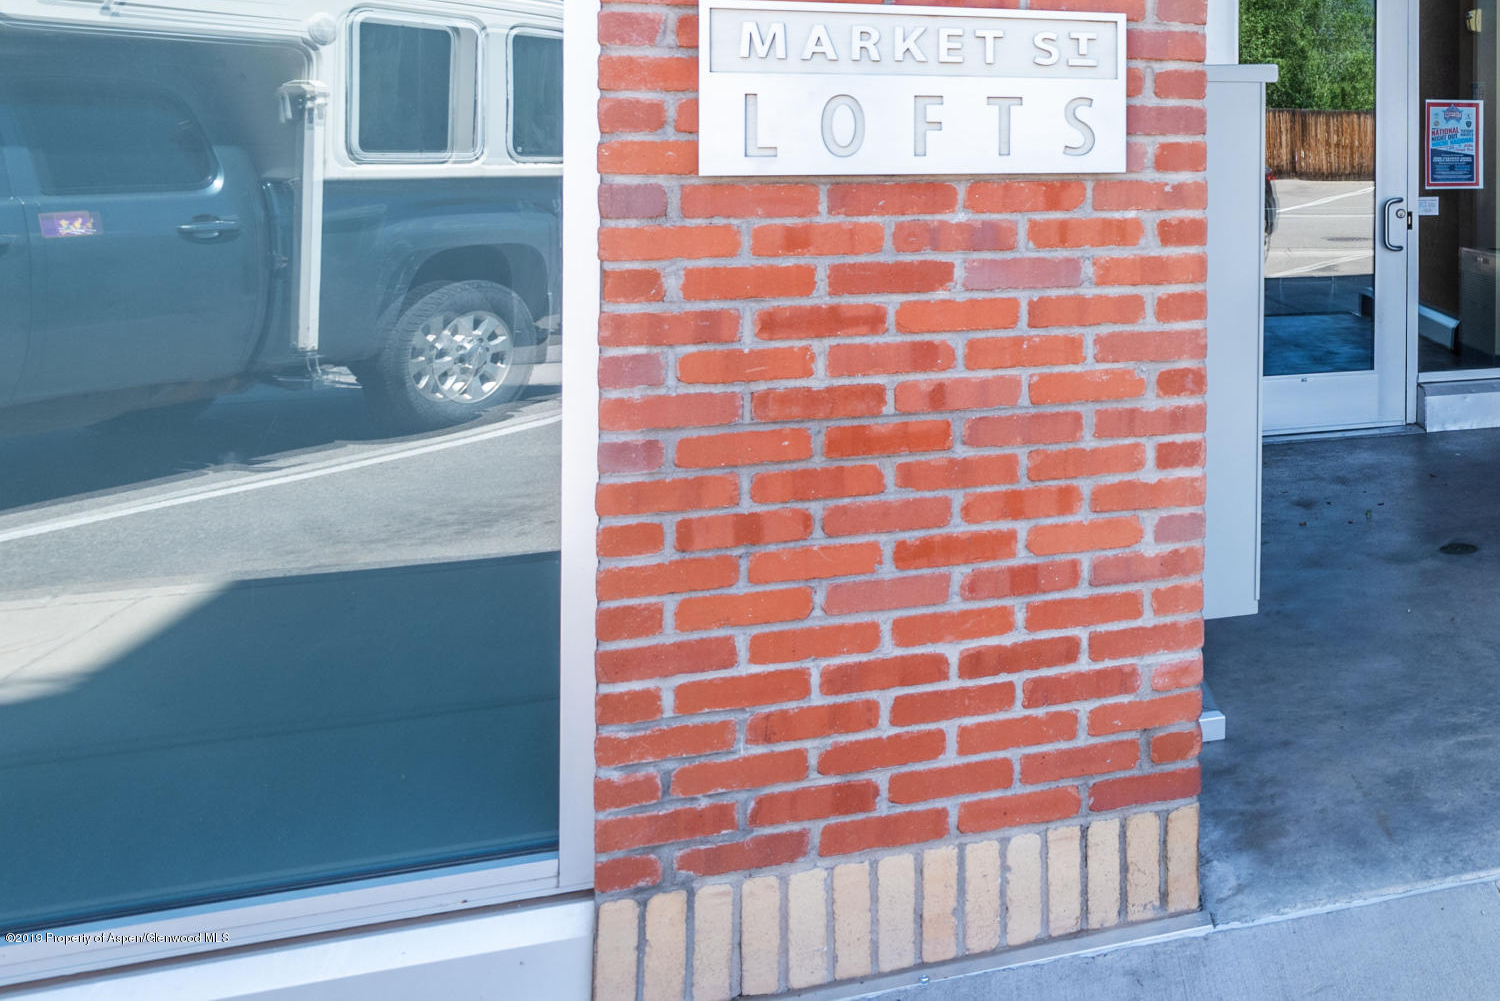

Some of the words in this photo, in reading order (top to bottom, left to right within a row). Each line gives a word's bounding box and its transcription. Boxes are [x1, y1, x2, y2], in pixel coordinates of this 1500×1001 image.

[738, 21, 1004, 65] MARKET
[1032, 31, 1098, 67] ST
[744, 93, 1097, 158] LOFTS
[1431, 127, 1459, 137] NATIONAL
